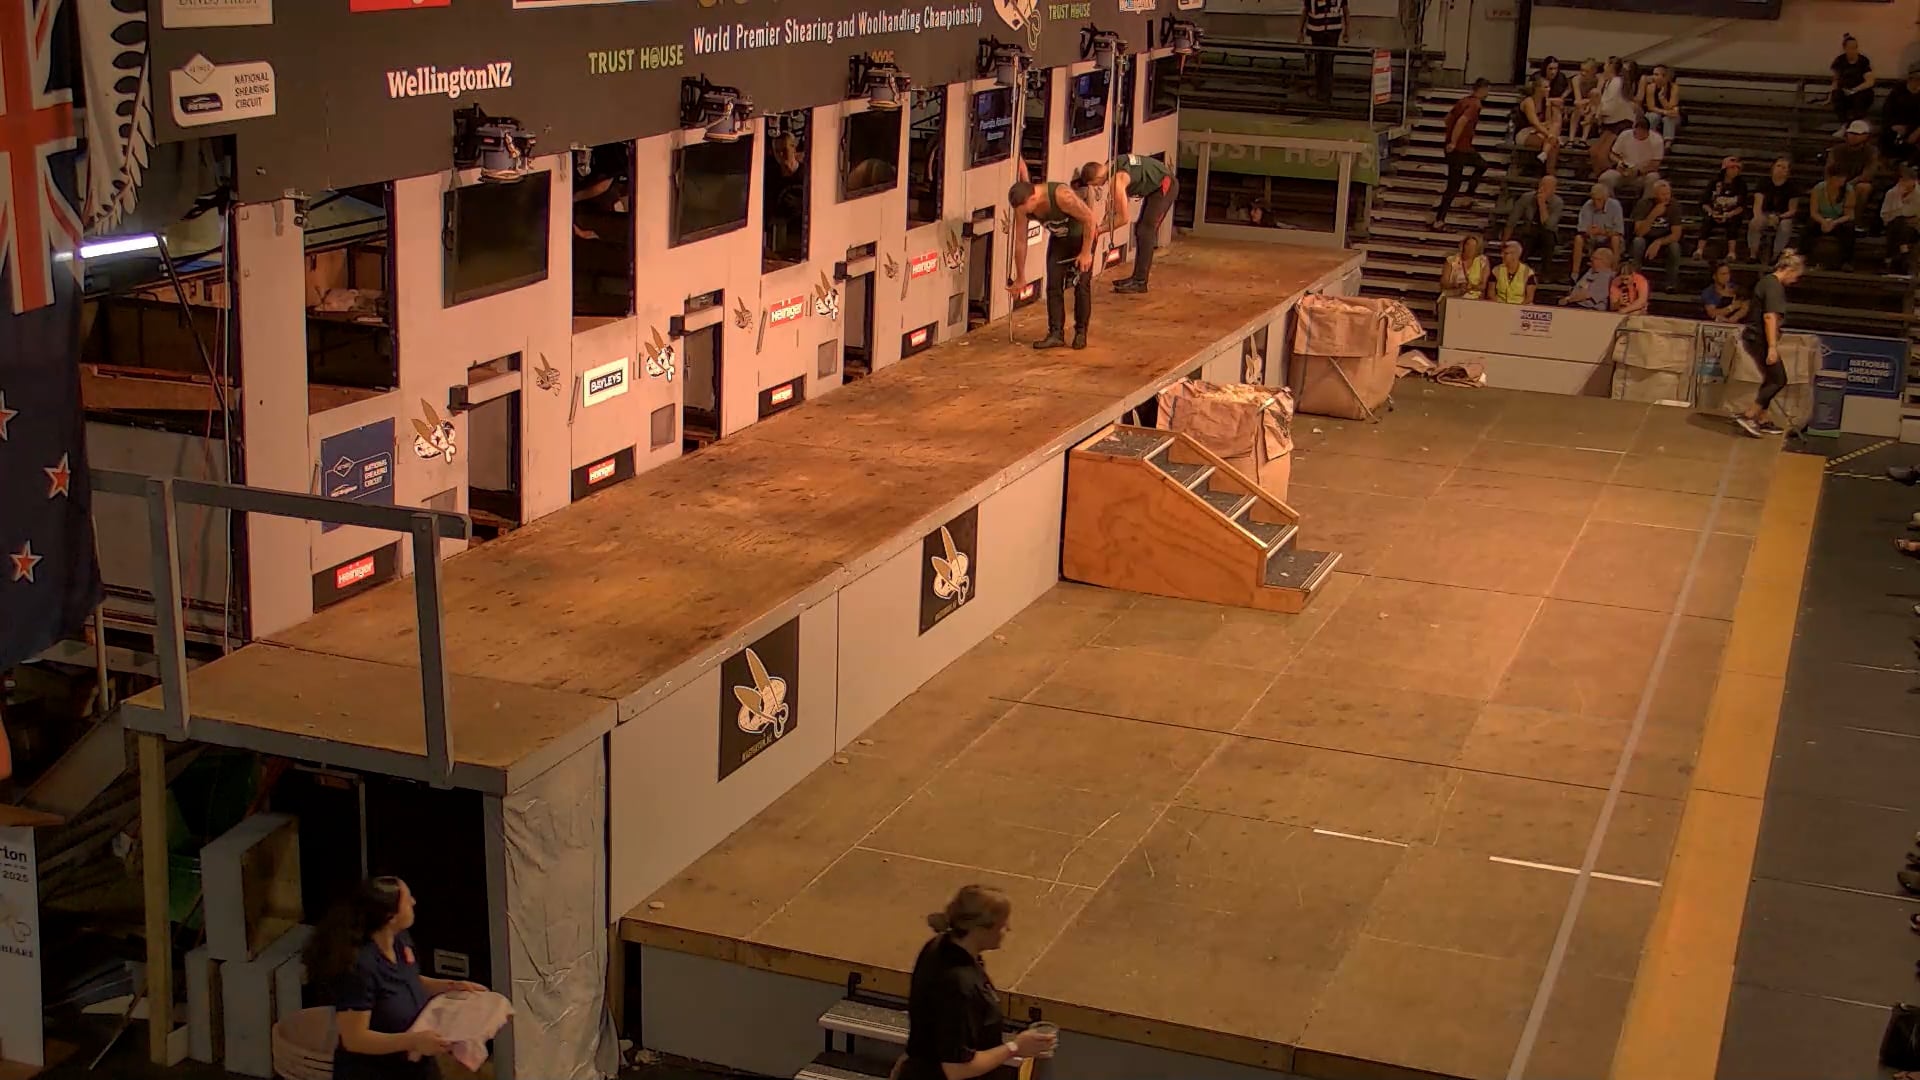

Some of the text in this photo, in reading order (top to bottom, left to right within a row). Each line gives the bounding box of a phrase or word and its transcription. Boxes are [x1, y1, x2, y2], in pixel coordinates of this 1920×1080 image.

[1049, 4, 1069, 20] TRUST
[694, 3, 982, 55] World Premier Shearing and Woolhandling Championship
[588, 45, 684, 75] TRUST HOUSE
[234, 72, 269, 84] NATIONAL
[387, 62, 512, 99] WellingtonNZ
[235, 84, 270, 97] SHEARING
[235, 97, 262, 109] CIRCUIT
[1521, 311, 1552, 320] NOTICE
[591, 372, 622, 392] BAYLEYS
